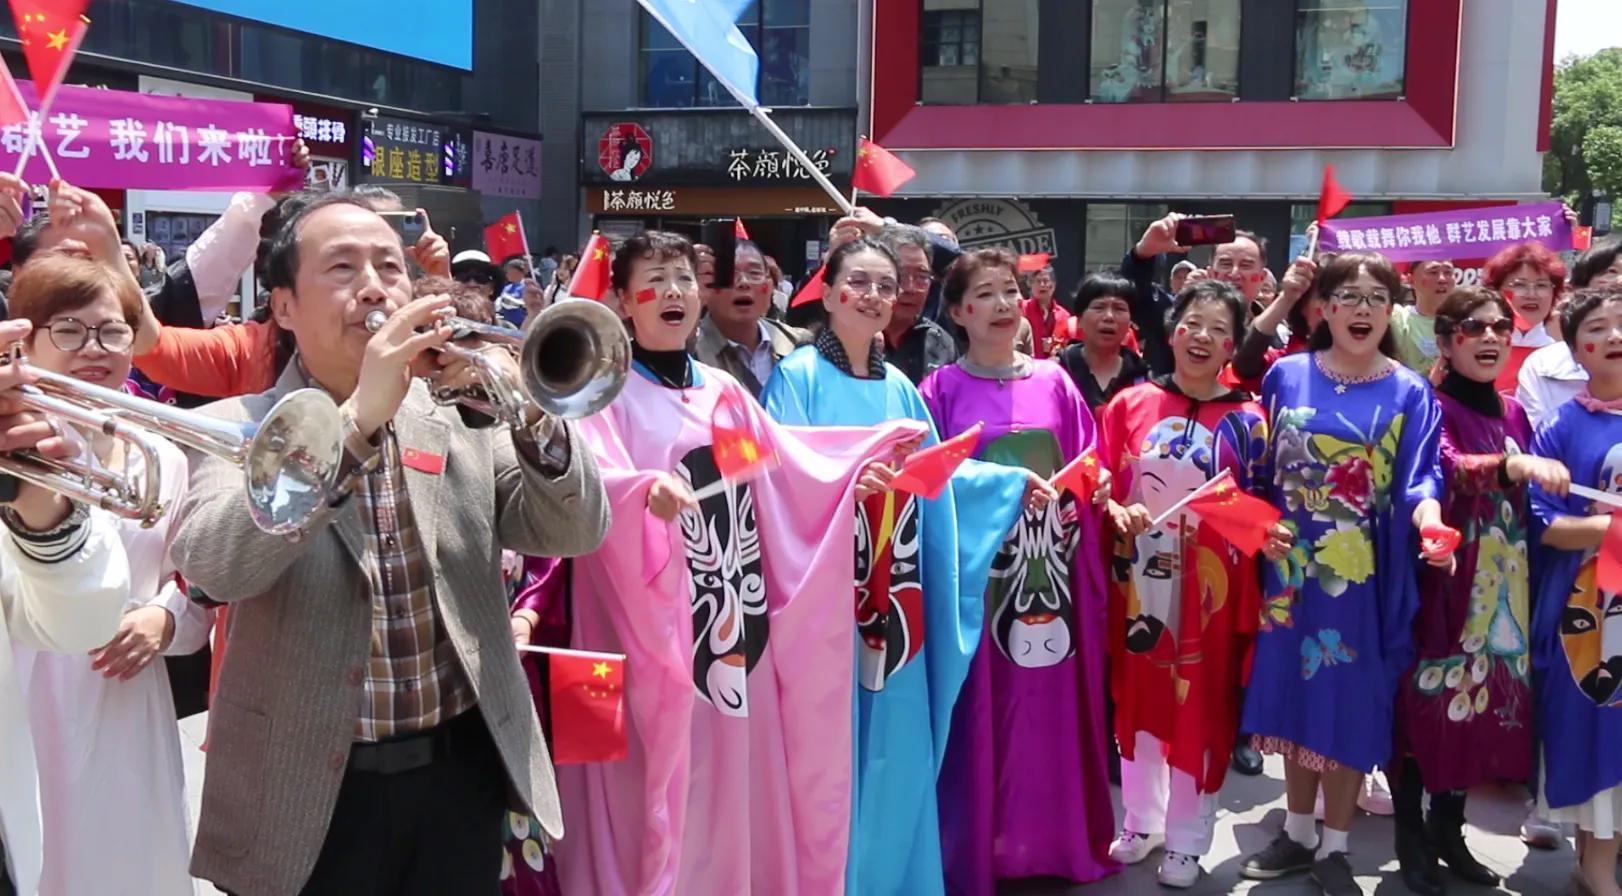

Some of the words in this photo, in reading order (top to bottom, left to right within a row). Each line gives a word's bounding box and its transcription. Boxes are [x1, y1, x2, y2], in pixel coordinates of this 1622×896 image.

[371, 145, 440, 182] 银座造型
[951, 202, 1004, 224] FRESHLY
[1446, 214, 1553, 244] 群艺发展靠大家
